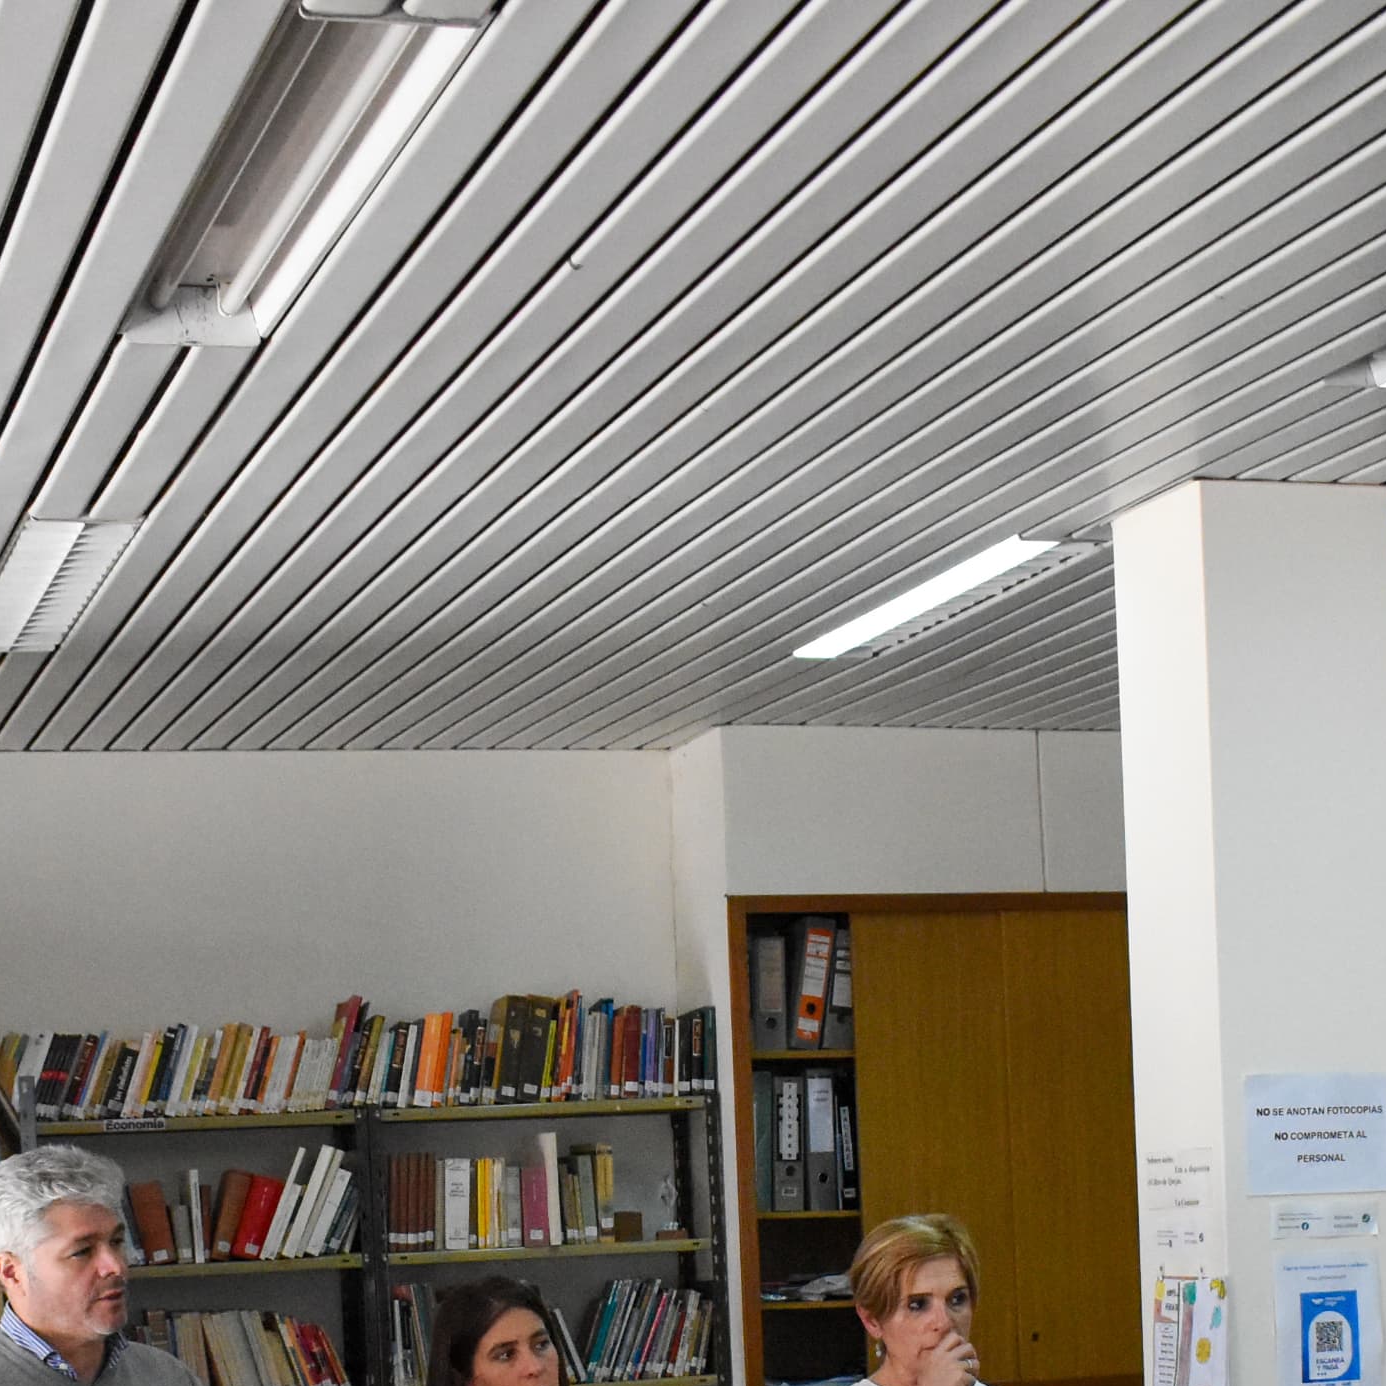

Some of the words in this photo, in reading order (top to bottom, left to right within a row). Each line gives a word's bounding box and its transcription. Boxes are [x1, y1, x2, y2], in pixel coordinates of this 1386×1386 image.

[1256, 1108, 1270, 1116] NO
[1272, 1108, 1284, 1116] SE
[1287, 1107, 1325, 1116] ANOTAN
[1326, 1105, 1383, 1115] FOTOCOPIAS
[1274, 1132, 1288, 1141] NO
[1290, 1131, 1354, 1140] COMPROMETA
[1356, 1130, 1367, 1138] AL
[1297, 1154, 1345, 1163] PERSONAL
